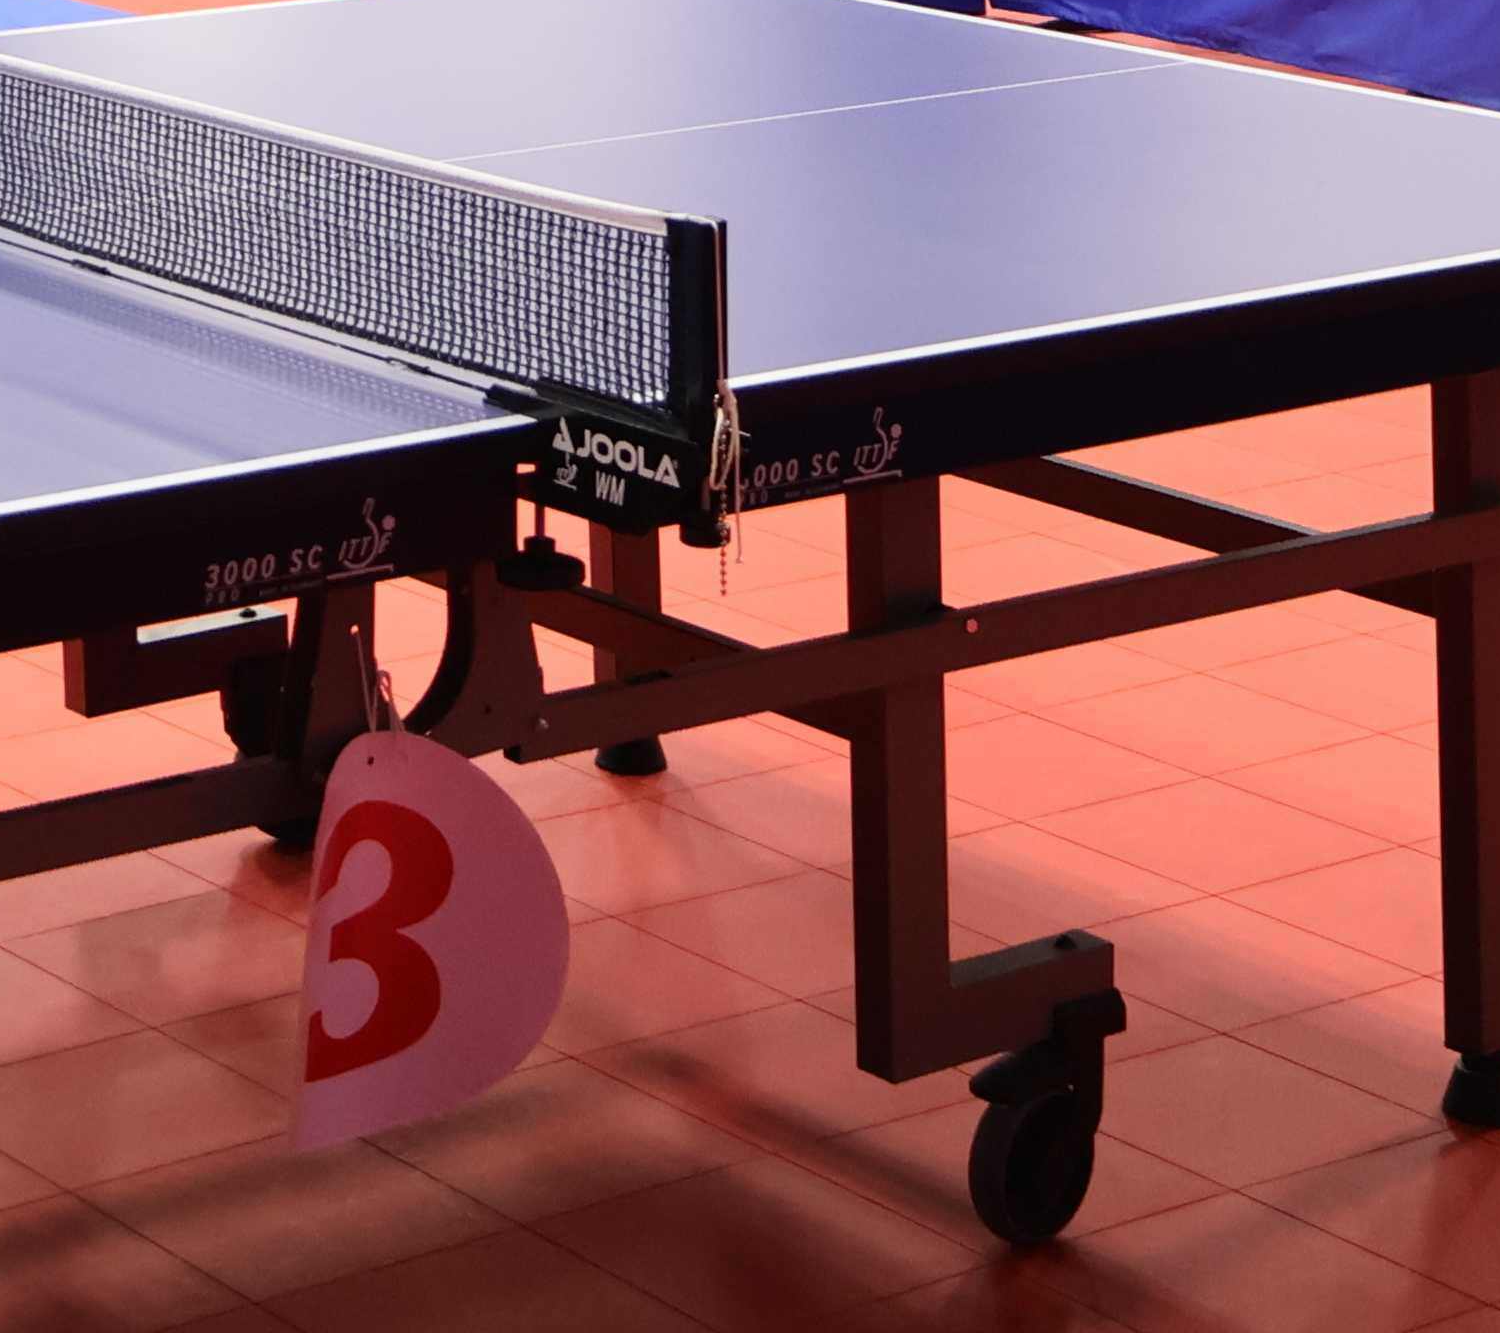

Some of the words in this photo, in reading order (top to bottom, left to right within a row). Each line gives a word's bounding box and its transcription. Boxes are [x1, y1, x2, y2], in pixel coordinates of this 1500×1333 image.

[576, 429, 681, 489] JOOLA
[743, 458, 799, 490] 000
[811, 450, 841, 477] SC
[596, 470, 626, 507] WM
[204, 553, 276, 589] 3000
[289, 544, 324, 574] SC
[304, 800, 454, 1083] 3
